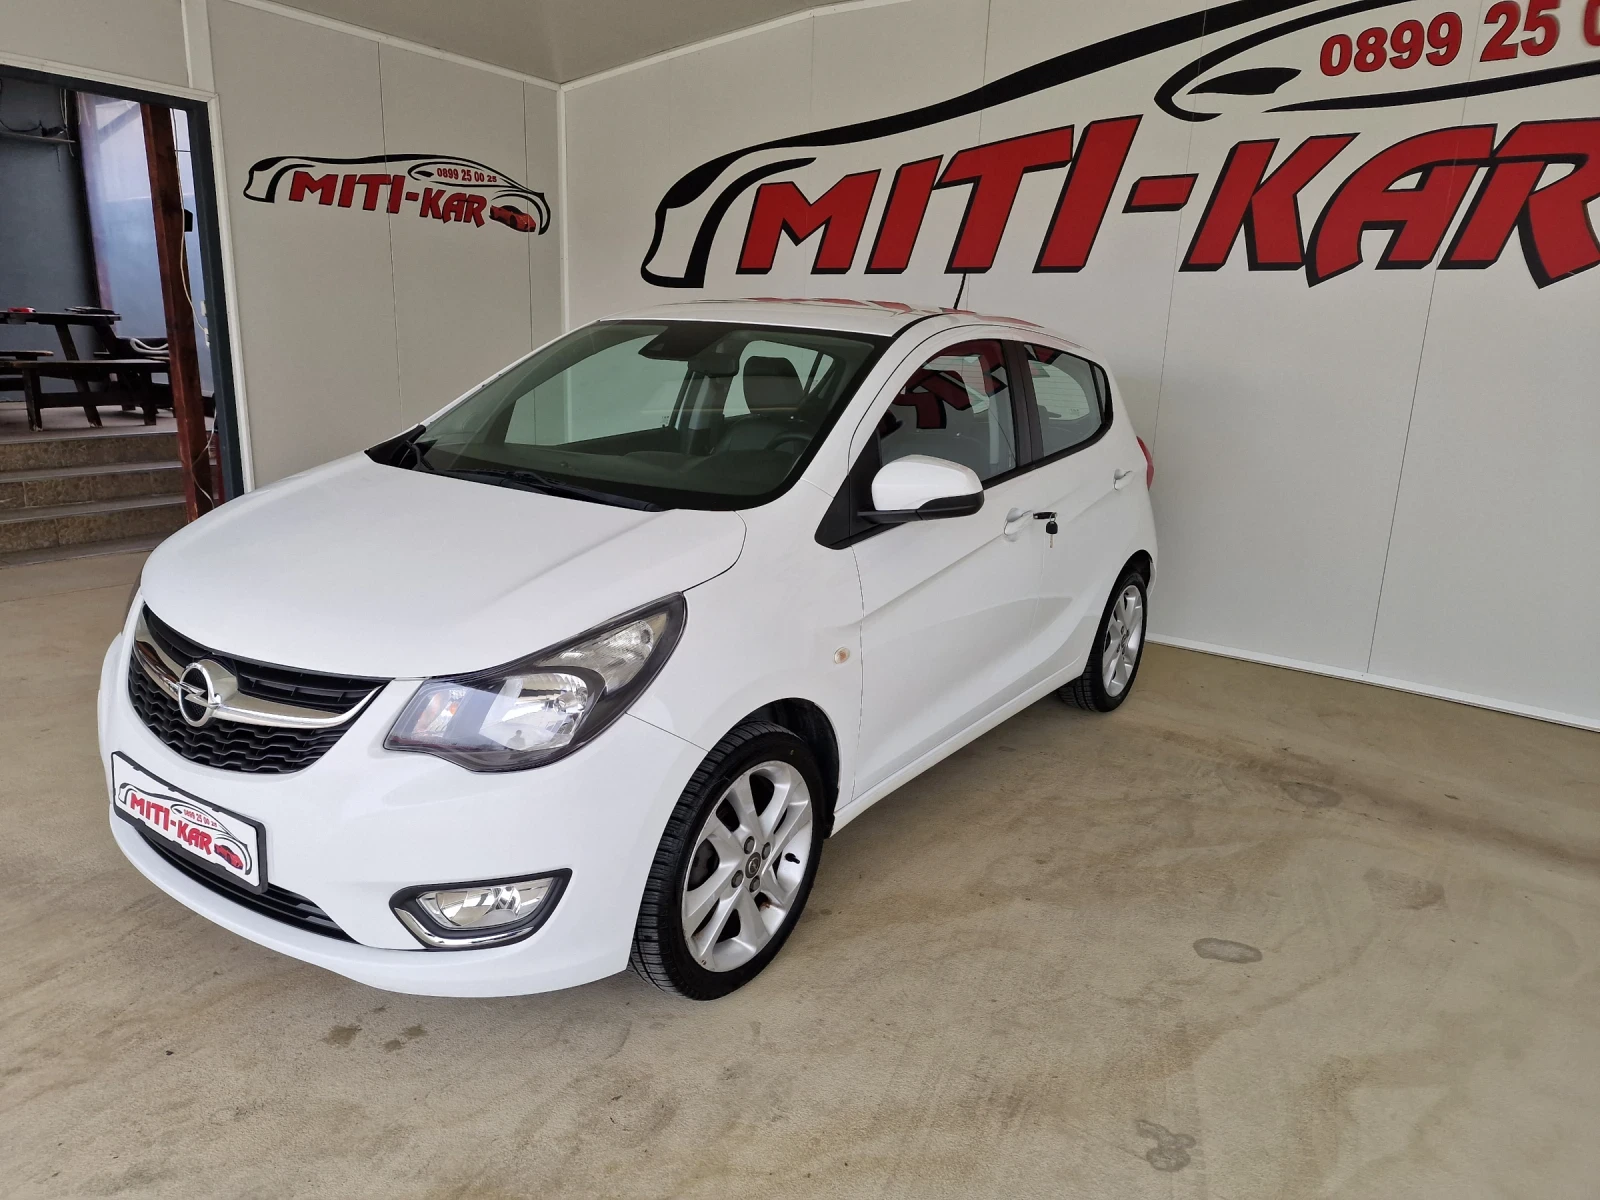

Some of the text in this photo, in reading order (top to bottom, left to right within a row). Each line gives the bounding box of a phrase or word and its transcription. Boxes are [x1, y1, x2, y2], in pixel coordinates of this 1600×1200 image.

[1319, 11, 1463, 76] 0899
[1480, 0, 1561, 62] 25
[289, 171, 487, 227] MITI-KAR
[436, 167, 497, 183] 0899 25 00 25
[735, 114, 1600, 289] MITI-KAR
[130, 792, 212, 855] MITI-KAR
